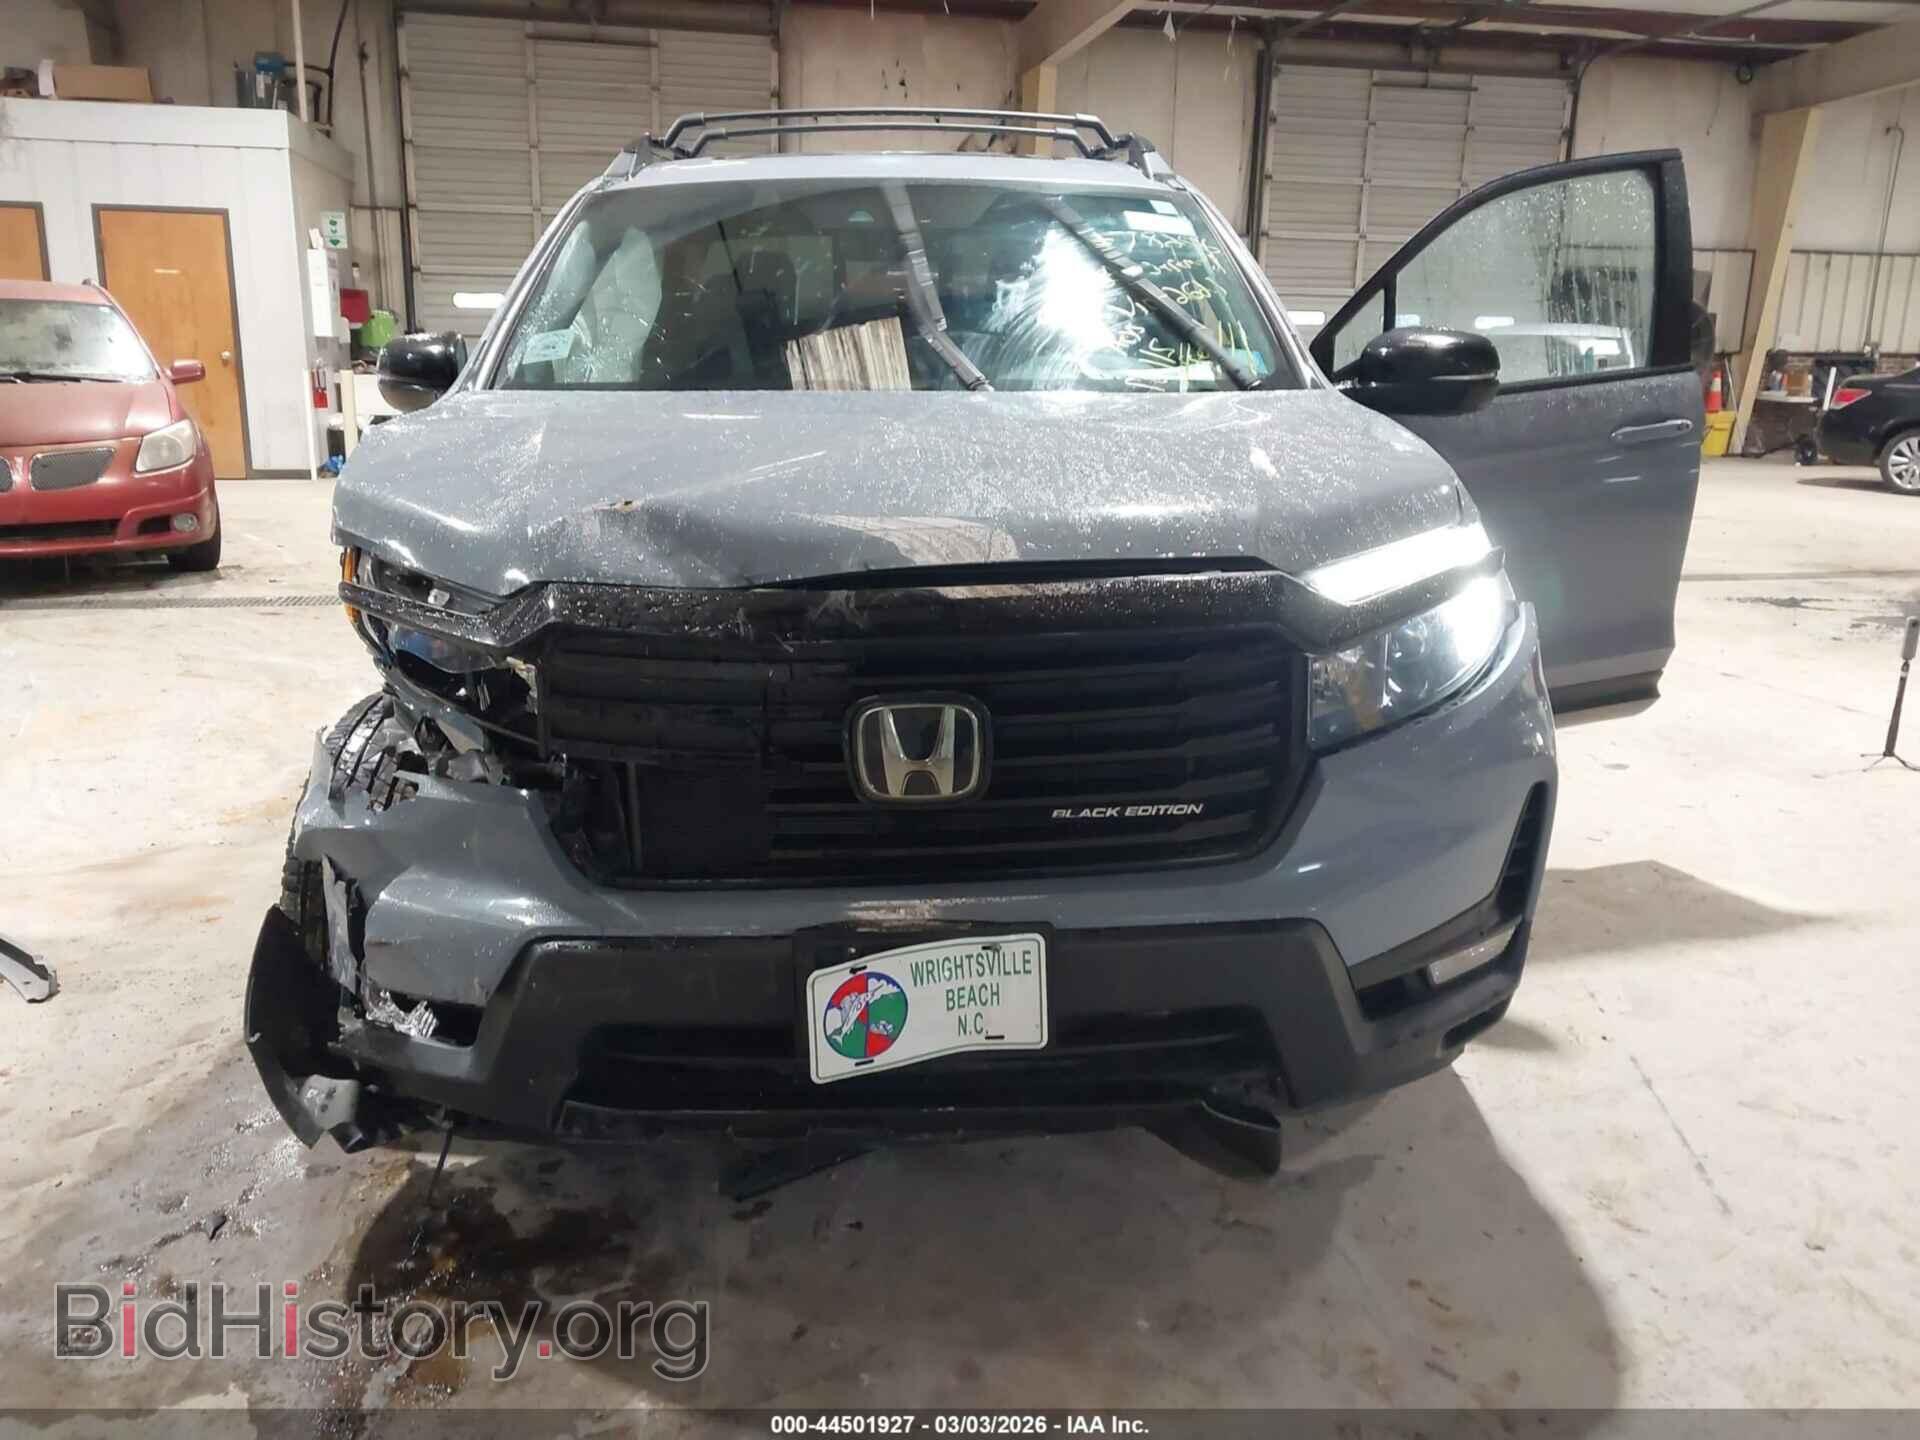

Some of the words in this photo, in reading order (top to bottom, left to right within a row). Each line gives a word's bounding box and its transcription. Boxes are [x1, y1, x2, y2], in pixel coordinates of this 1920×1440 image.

[1051, 806, 1121, 819] BLACK
[1124, 803, 1204, 817] EDITION
[910, 950, 1032, 988] WRIGHTSVILLE
[945, 982, 1001, 1012] BEACH
[958, 1012, 989, 1037] N.C.
